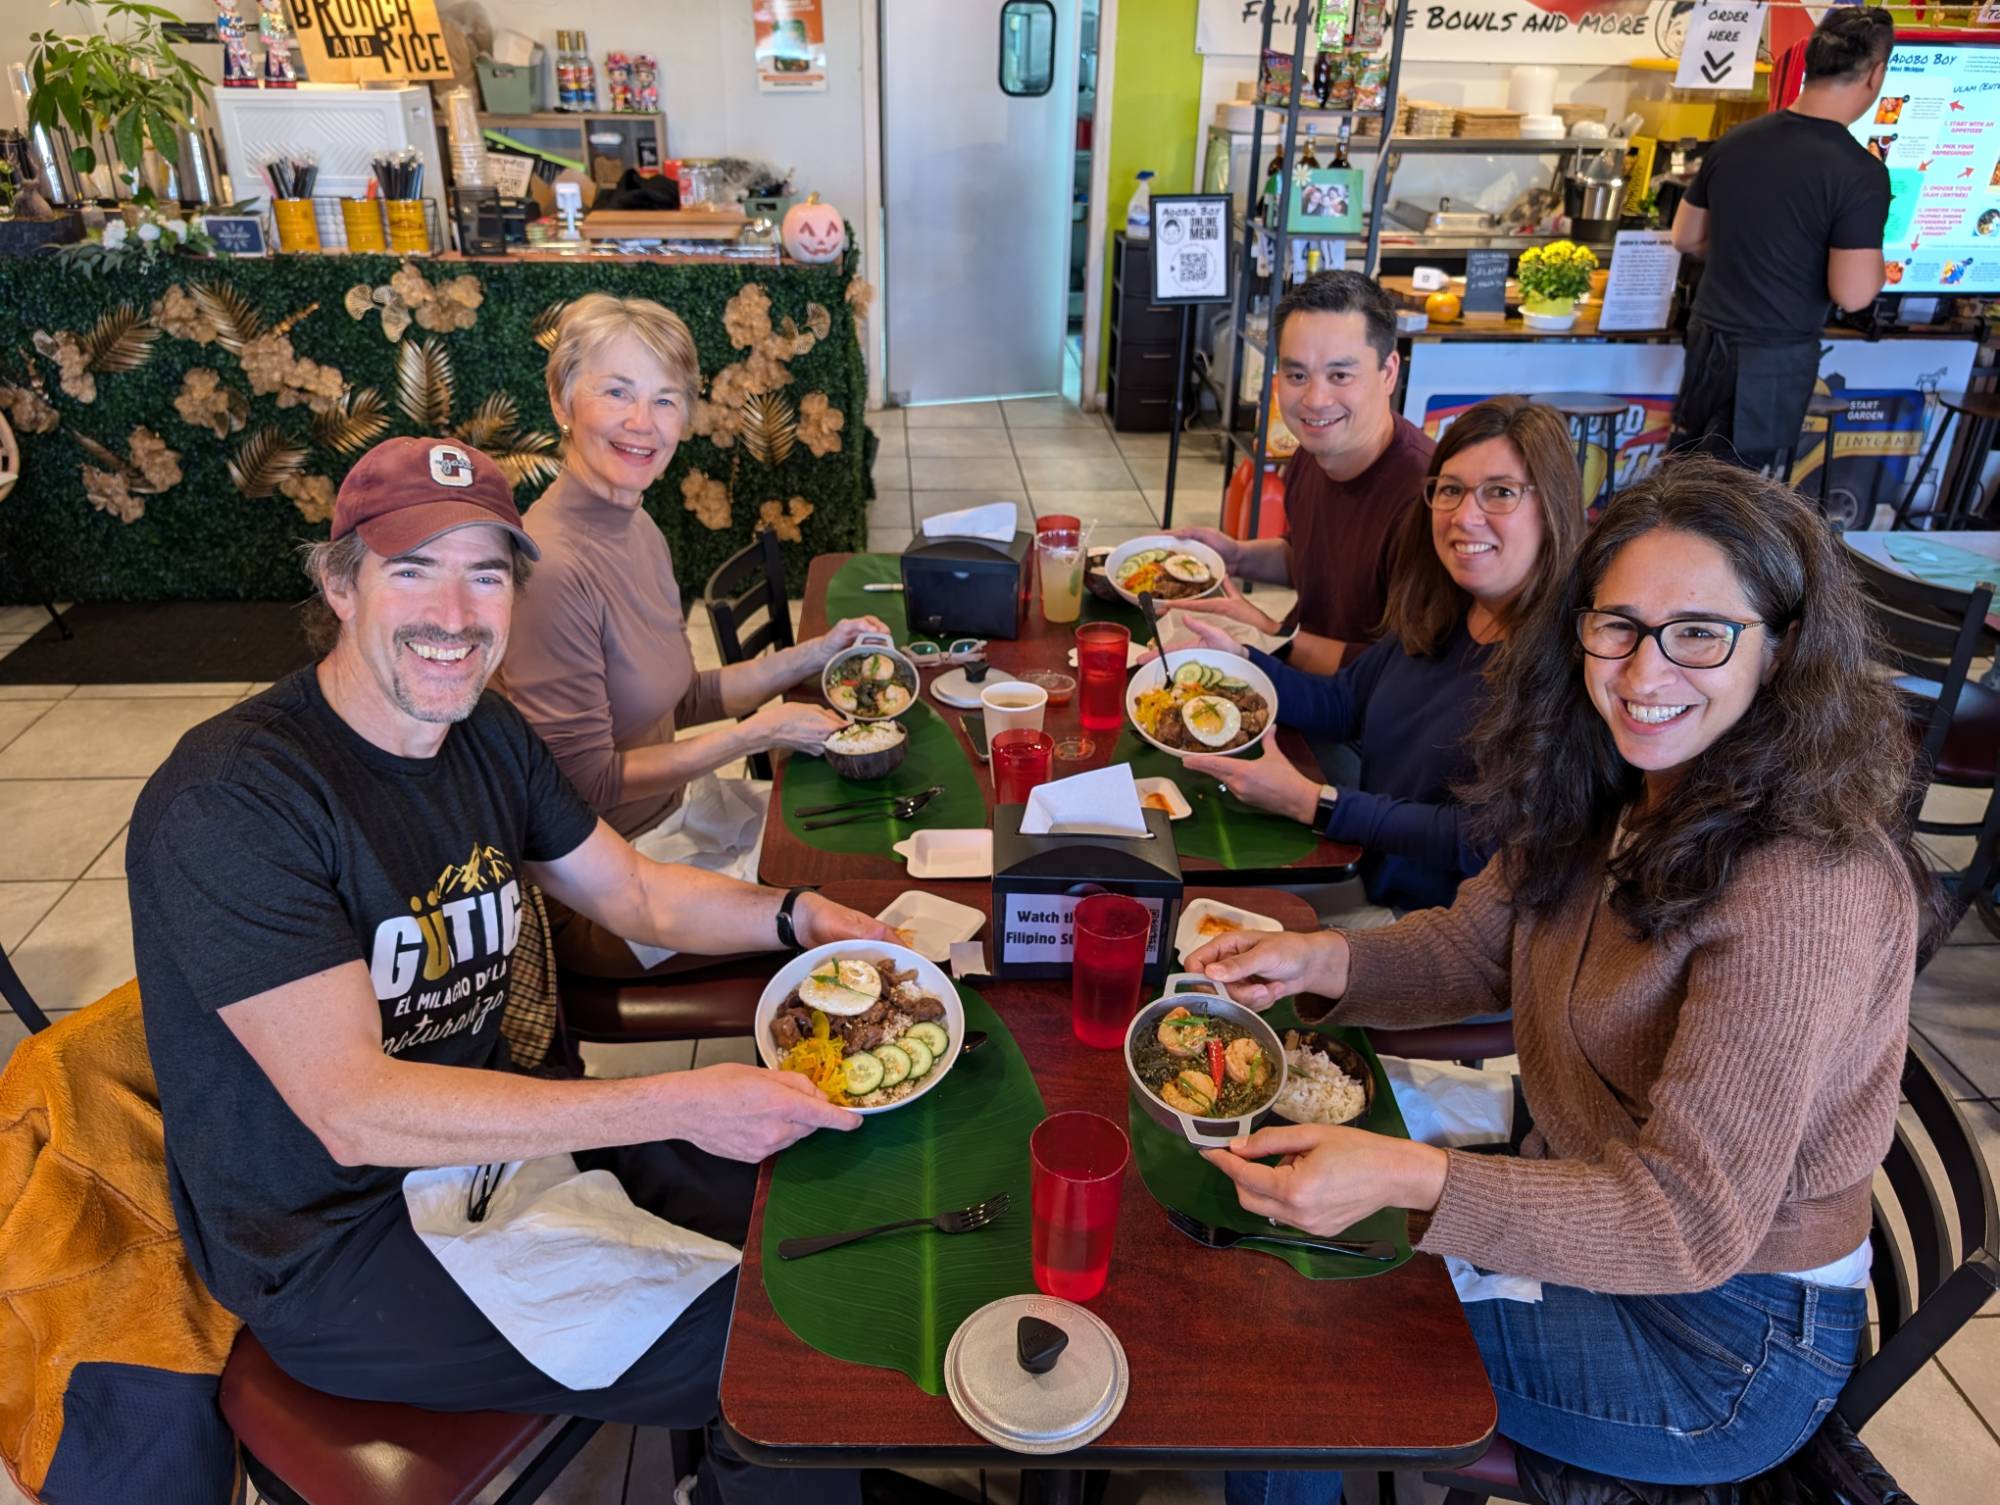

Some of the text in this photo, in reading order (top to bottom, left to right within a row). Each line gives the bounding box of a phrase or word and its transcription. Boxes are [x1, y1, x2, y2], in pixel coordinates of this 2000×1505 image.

[290, 0, 418, 38] BRUNCH
[1426, 6, 1517, 31] BOWLS
[1522, 14, 1568, 32] AND
[1577, 14, 1649, 35] MORE
[1708, 10, 1749, 22] ORDER
[1707, 31, 1741, 41] HERE
[334, 37, 373, 57] AND
[375, 28, 449, 73] RICE
[1189, 217, 1218, 227] ONLINE
[1189, 228, 1218, 240] MENU
[1849, 400, 1880, 411] START
[1847, 411, 1885, 421] GARDEN
[1017, 911, 1060, 924] Watch
[1006, 932, 1056, 946] Filipino
[393, 996, 412, 1018] EL
